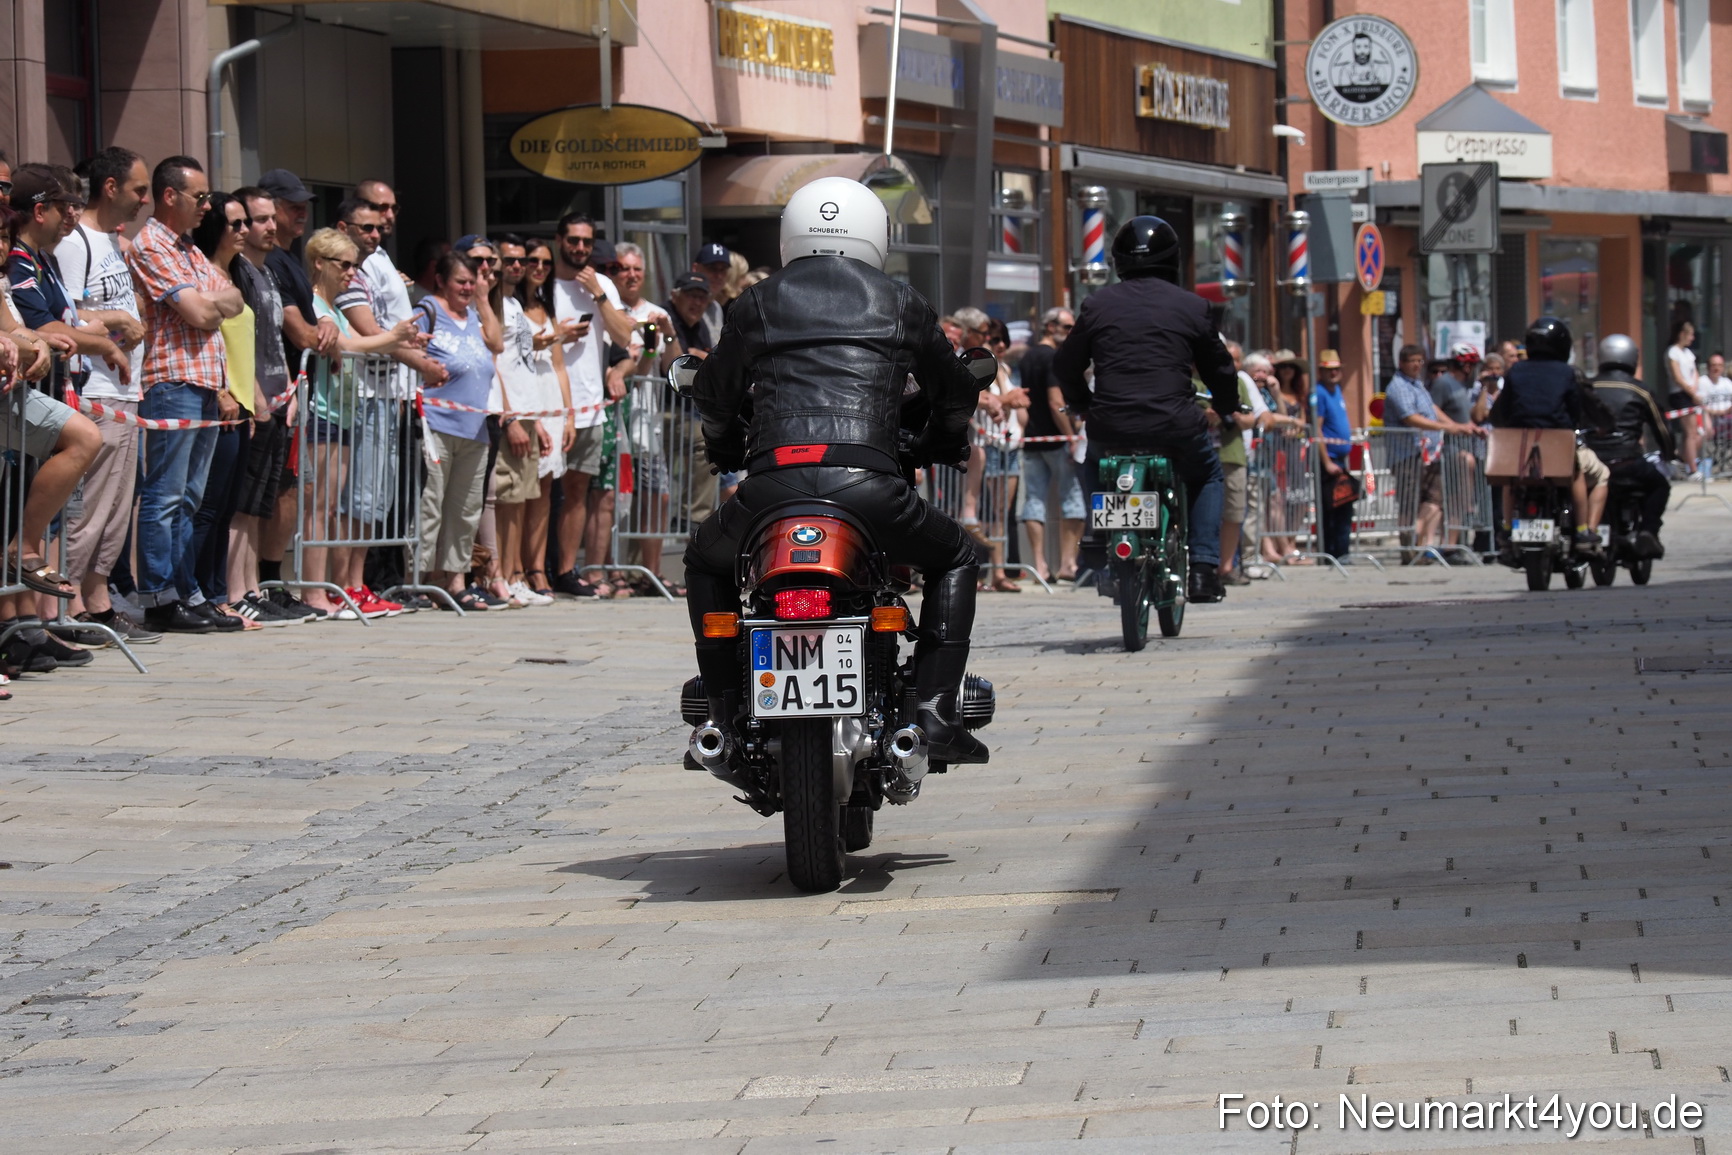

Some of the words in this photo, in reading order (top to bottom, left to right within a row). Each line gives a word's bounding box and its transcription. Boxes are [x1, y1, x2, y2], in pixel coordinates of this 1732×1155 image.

[520, 139, 549, 154] DIE
[554, 137, 698, 154] GOLDSCHMIEDE
[1444, 133, 1528, 161] Creppresso
[567, 161, 600, 171] JUTTA
[602, 160, 646, 170] ROTHER
[1308, 174, 1359, 187] Klostergasse
[808, 227, 848, 235] SCHUBERTH
[1105, 496, 1126, 510] NM
[1121, 511, 1141, 527] 13
[836, 634, 852, 644] 04
[776, 634, 824, 671] NM
[759, 655, 767, 666] D
[838, 658, 853, 669] 10
[781, 675, 804, 711] A
[812, 673, 858, 709] 15
